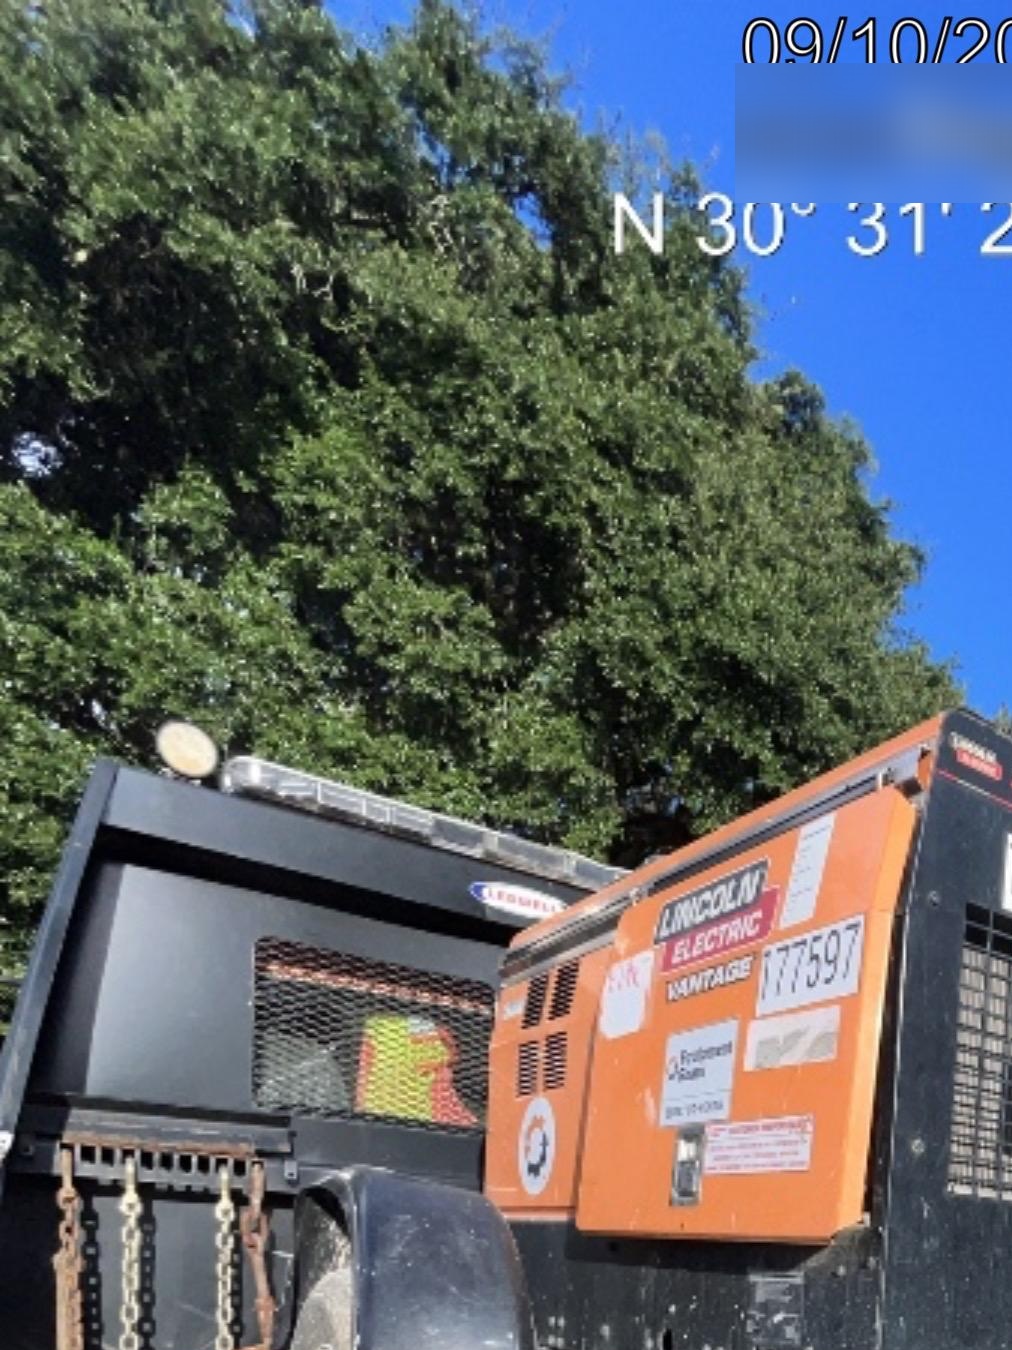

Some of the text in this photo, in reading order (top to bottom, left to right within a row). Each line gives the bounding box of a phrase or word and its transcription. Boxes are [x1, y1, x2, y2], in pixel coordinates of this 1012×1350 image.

[659, 868, 762, 939] LINCOLN
[671, 910, 763, 964] ELECTRIC
[762, 921, 860, 1000] 177597
[667, 955, 755, 1002] VANTAGE
